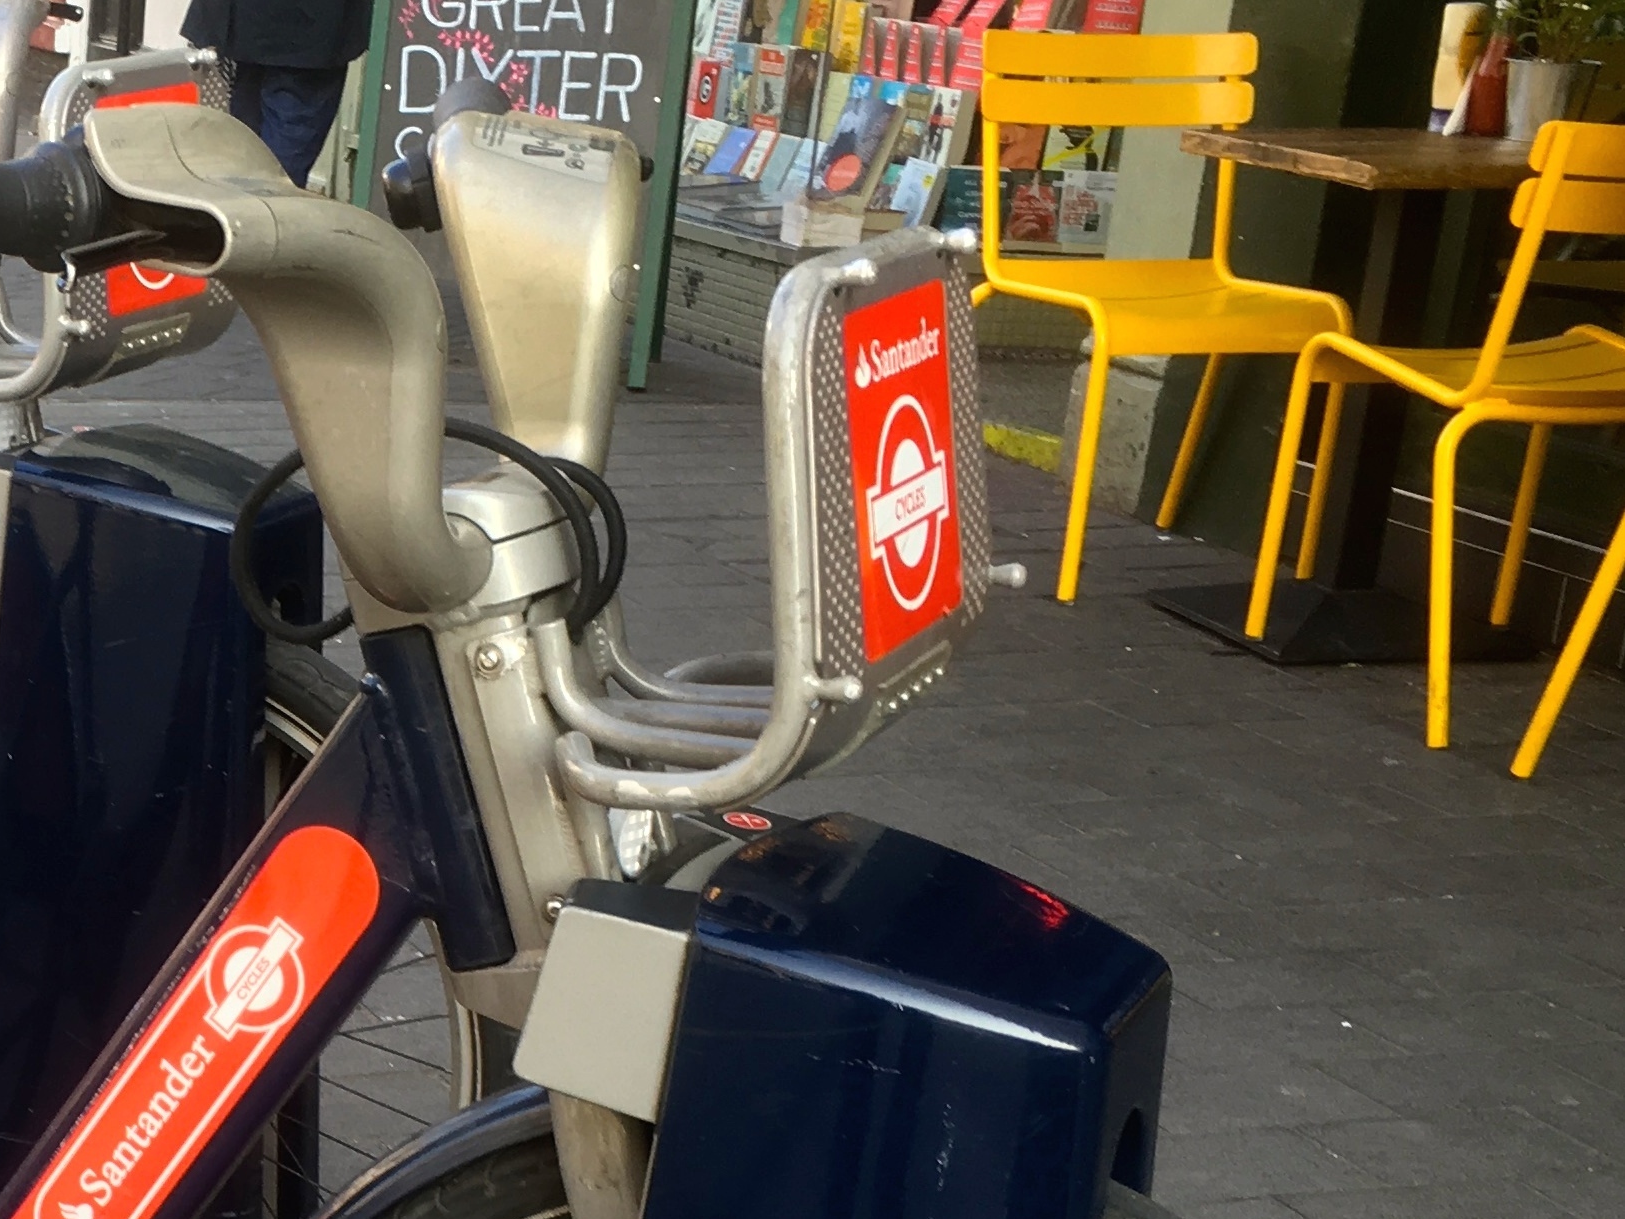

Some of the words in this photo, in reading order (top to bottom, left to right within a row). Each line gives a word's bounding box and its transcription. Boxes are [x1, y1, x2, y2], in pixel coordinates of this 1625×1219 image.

[870, 317, 940, 383] Santander
[894, 486, 927, 521] CYCLES
[236, 956, 271, 1002] CYCLES
[79, 1033, 216, 1208] Santander
